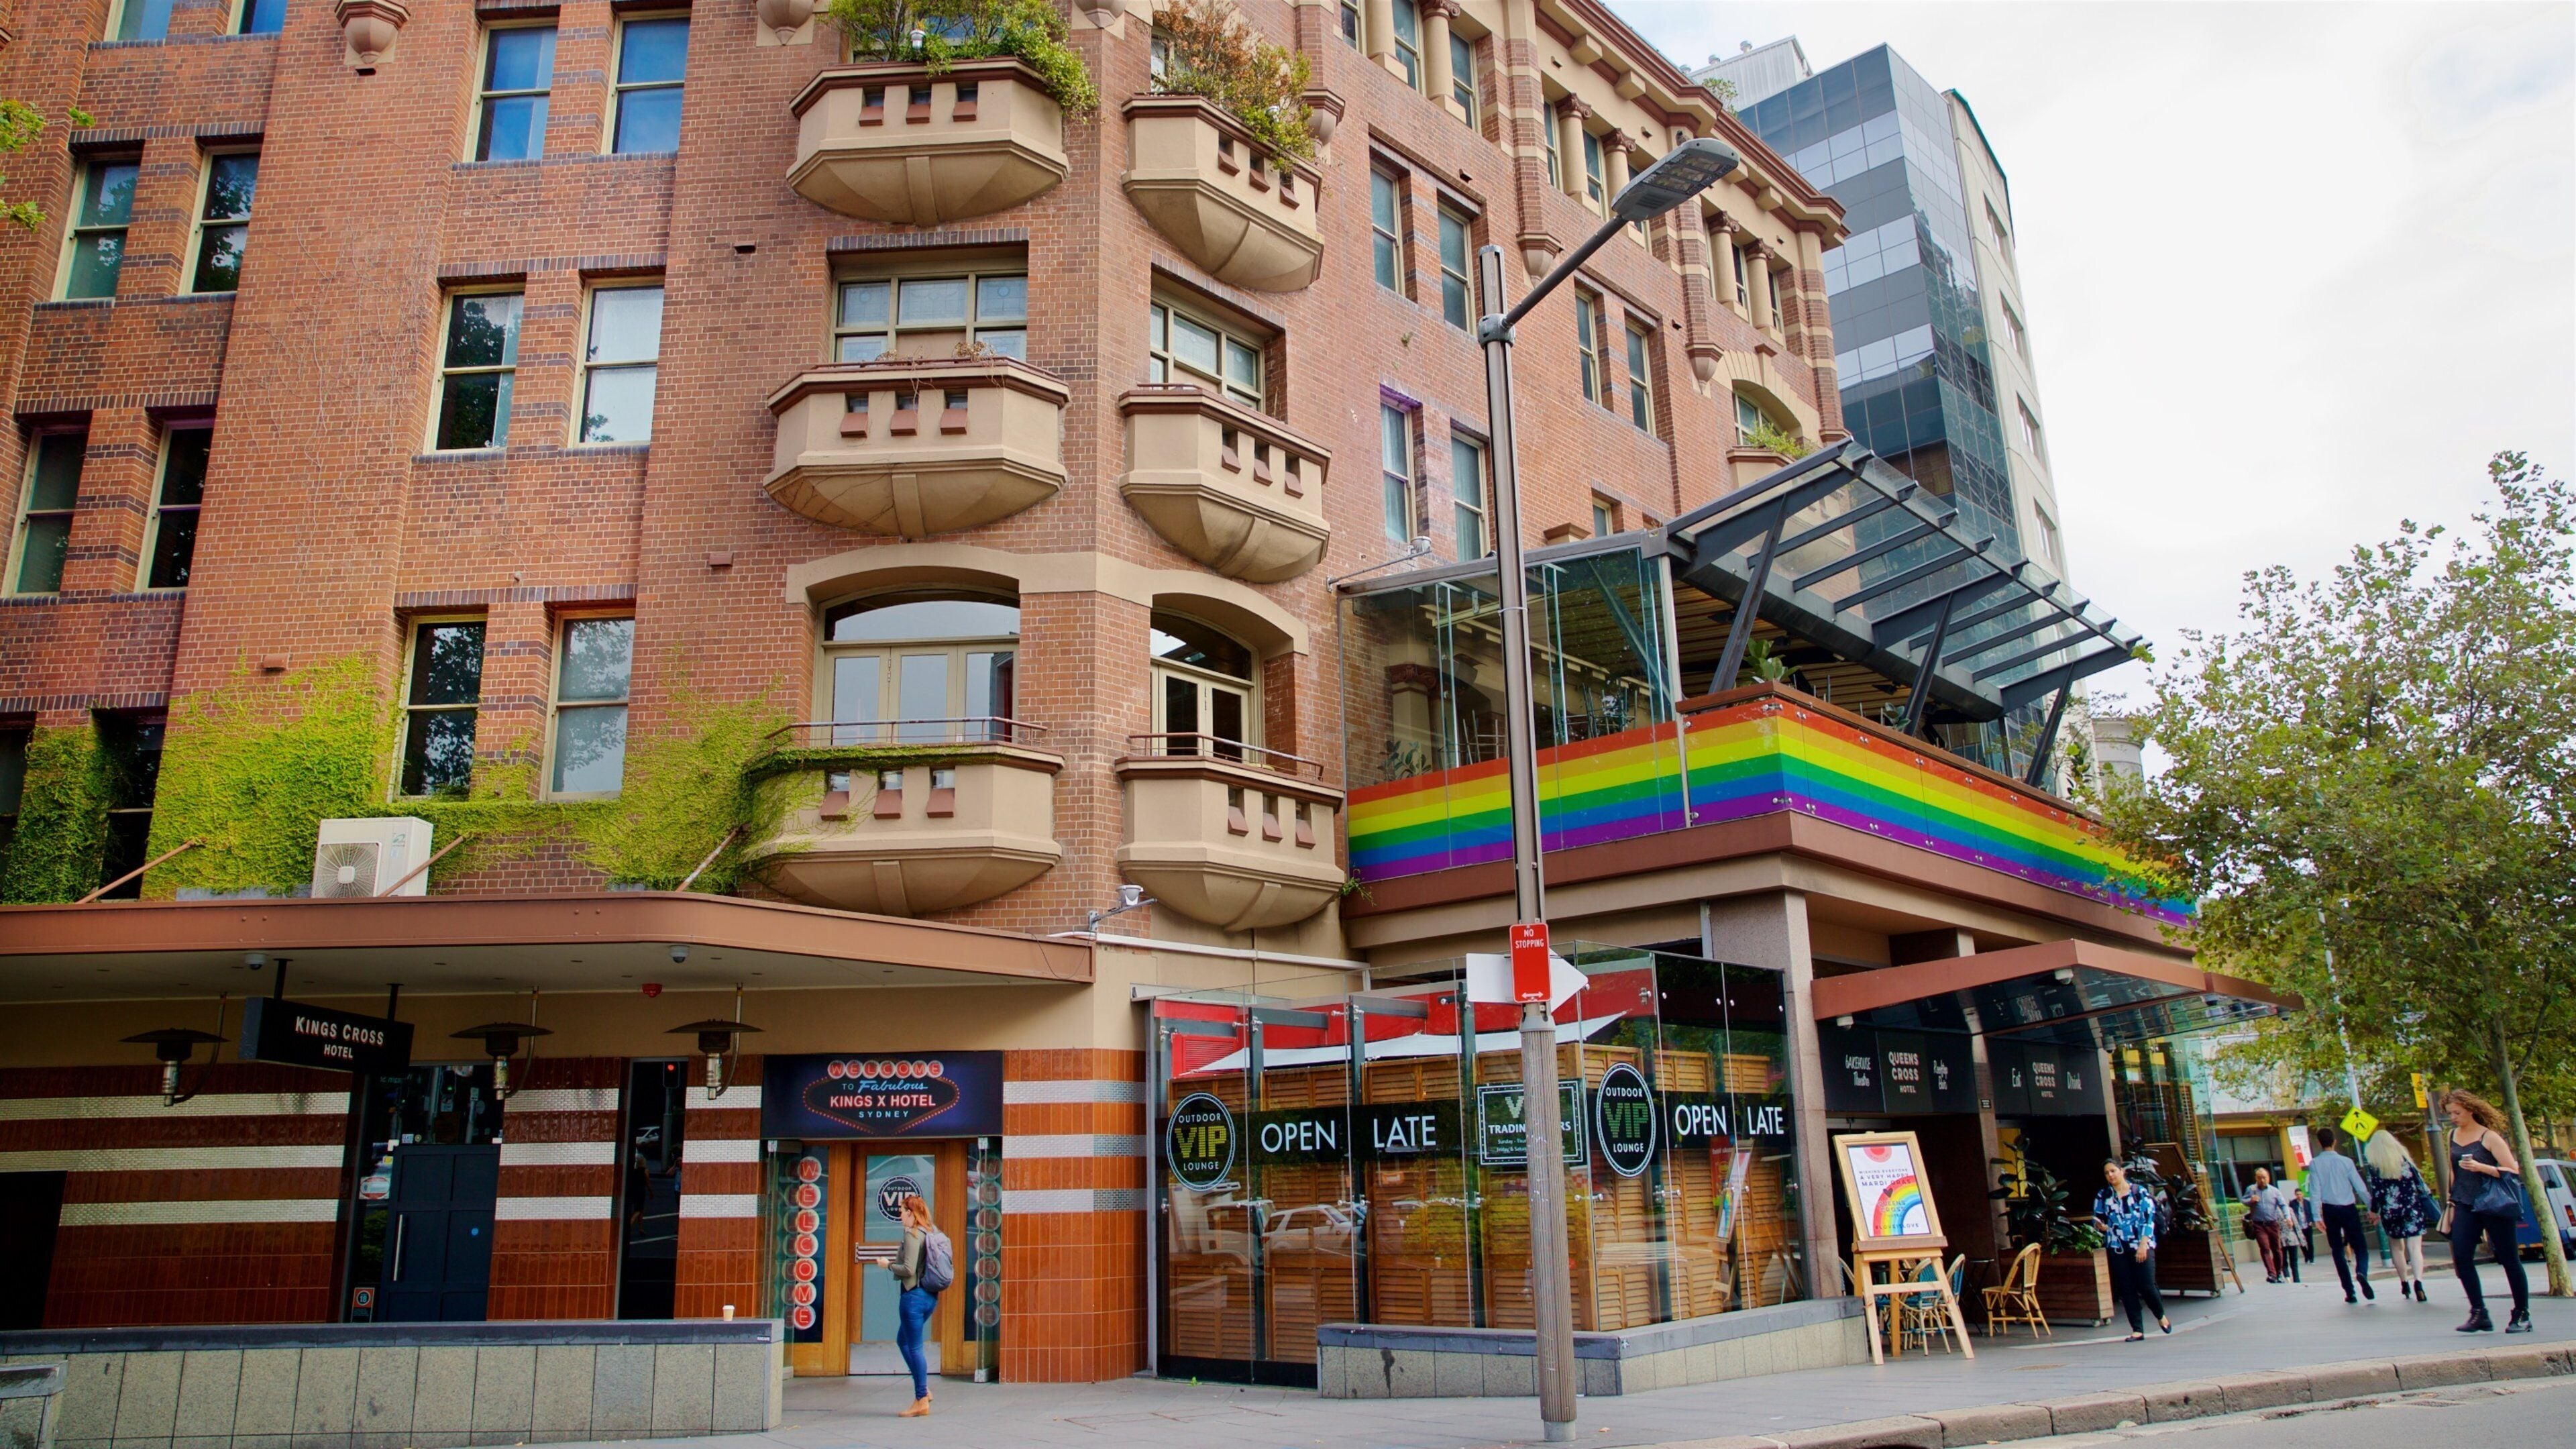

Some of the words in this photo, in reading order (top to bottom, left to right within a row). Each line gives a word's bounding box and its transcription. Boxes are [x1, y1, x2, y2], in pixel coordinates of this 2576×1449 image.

[1523, 928, 1534, 937] NO
[1515, 938, 1544, 949] STOPPING
[295, 1016, 337, 1038] KINGS
[343, 1024, 384, 1045] CROSS
[324, 1044, 354, 1059] HOTEL
[1888, 1051, 1919, 1066] QUEENS
[831, 1064, 941, 1074] WELCOME
[2032, 1062, 2055, 1073] QUEENS
[1892, 1068, 1919, 1081] CROSS
[858, 1079, 928, 1093] Fabulous
[2035, 1076, 2056, 1087] CROSS
[1606, 1087, 1643, 1097] OUTDOOR
[1900, 1085, 1917, 1093] HOTEL
[830, 1096, 873, 1108] KINGS
[877, 1096, 885, 1108] X
[891, 1095, 936, 1107] HOTEL
[1178, 1112, 1222, 1124] OUTDOOR
[1603, 1102, 1648, 1138] VIP
[1676, 1104, 1727, 1136] OPEN
[1748, 1106, 1784, 1135] LATE
[1261, 1120, 1336, 1152] OPEN
[1373, 1115, 1436, 1148] LATE
[1488, 1123, 1526, 1134] TRADIN
[1175, 1125, 1227, 1159] VIP
[1613, 1142, 1644, 1153] LOUNGE
[1183, 1161, 1220, 1171] LOUNGE
[799, 1163, 816, 1323] WELCOME
